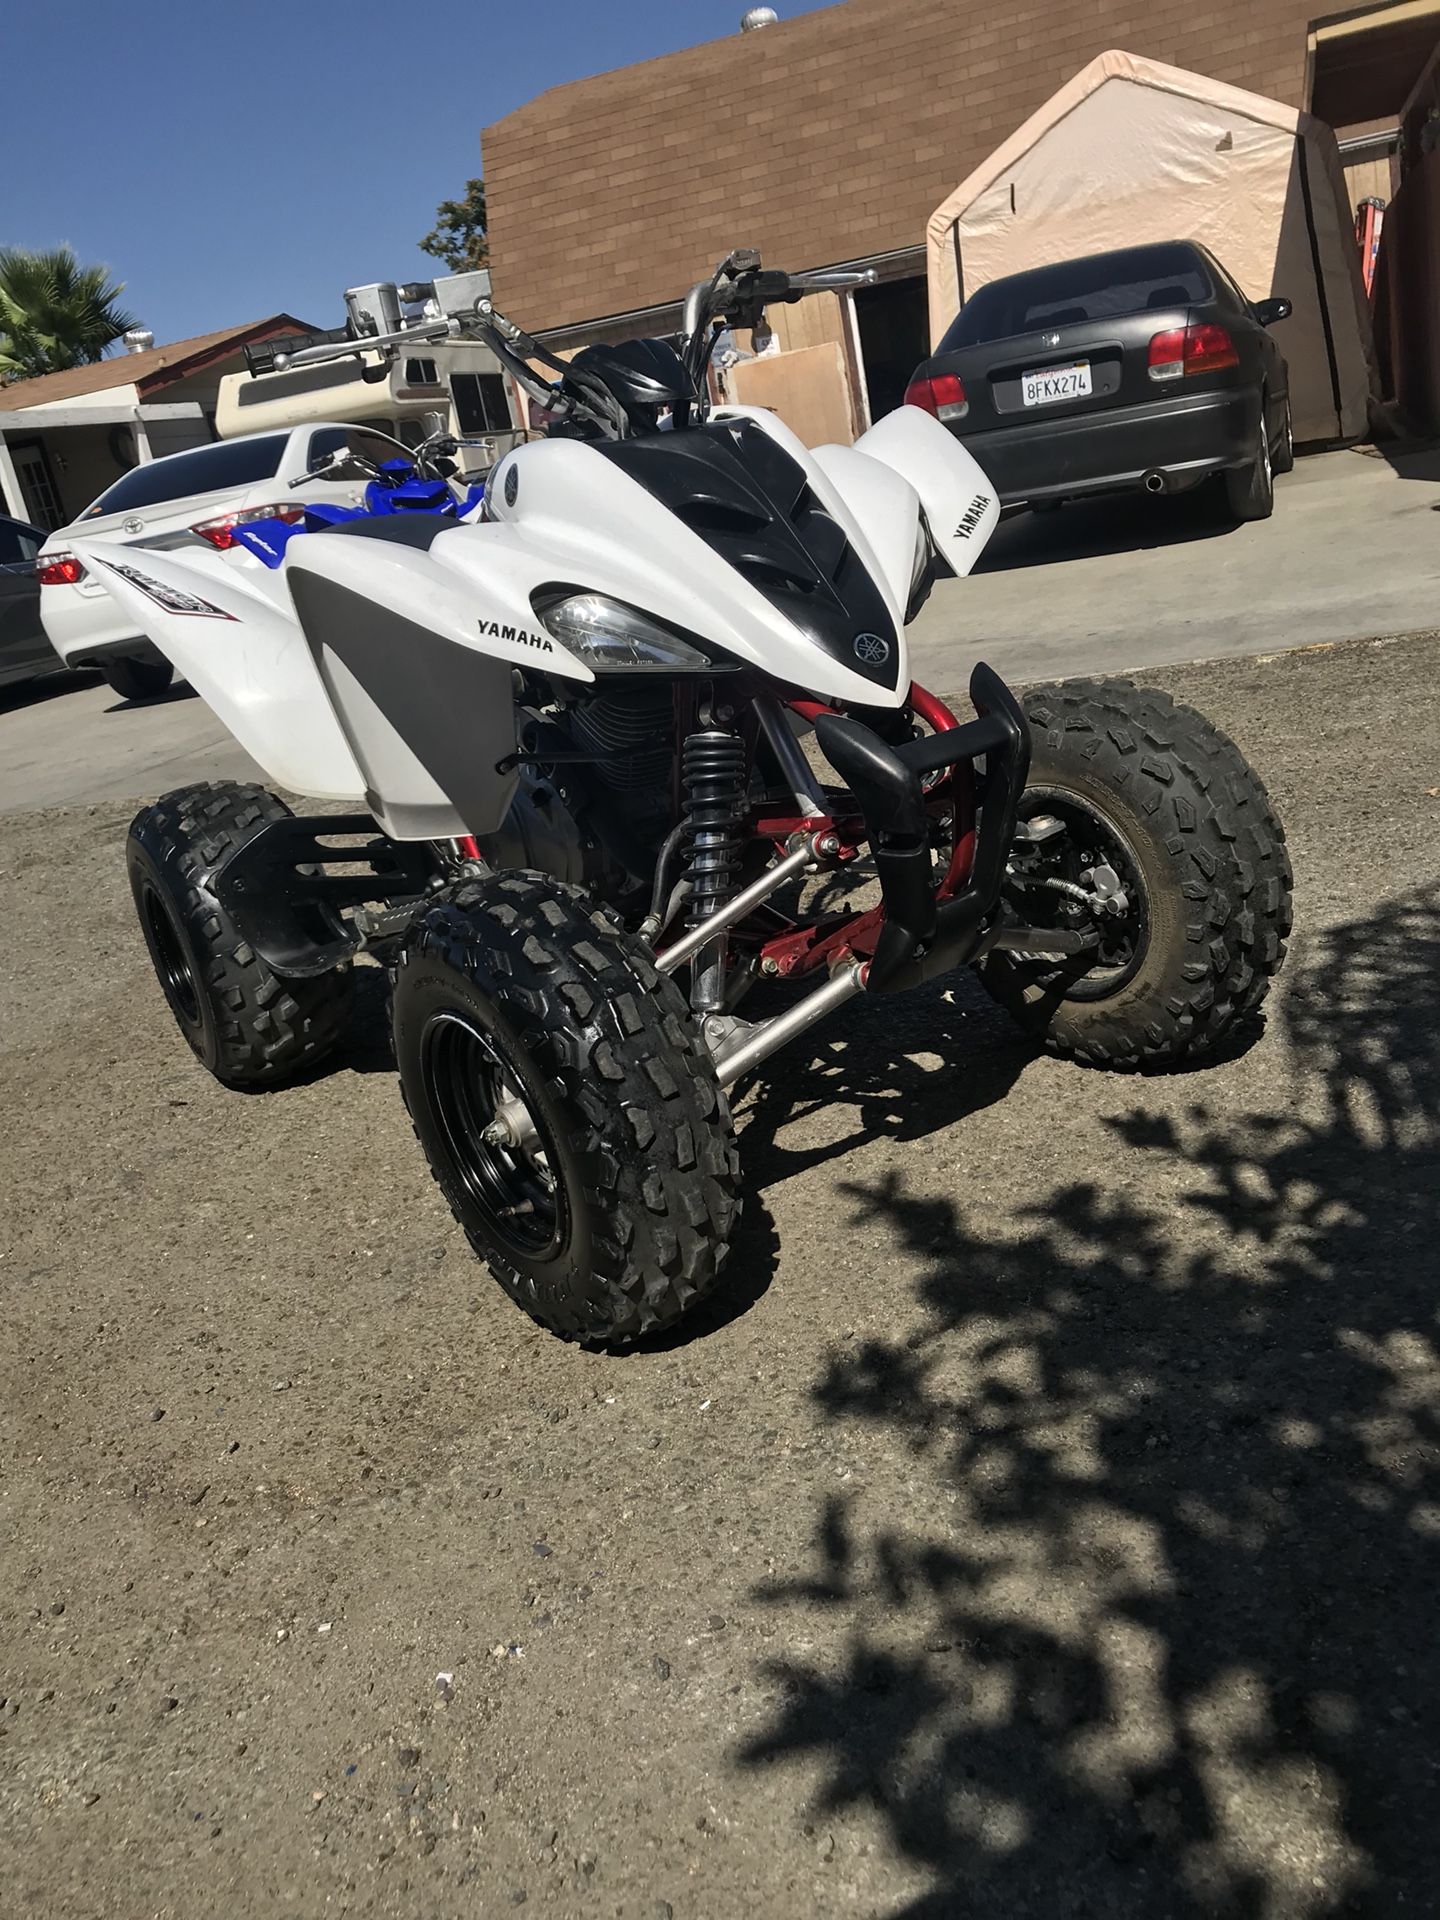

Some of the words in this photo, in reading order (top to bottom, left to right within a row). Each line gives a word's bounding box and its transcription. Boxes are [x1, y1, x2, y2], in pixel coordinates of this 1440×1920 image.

[1027, 374, 1086, 400] 8FKX274
[953, 494, 991, 539] YAMAHA
[478, 619, 553, 653] YAMAHA
